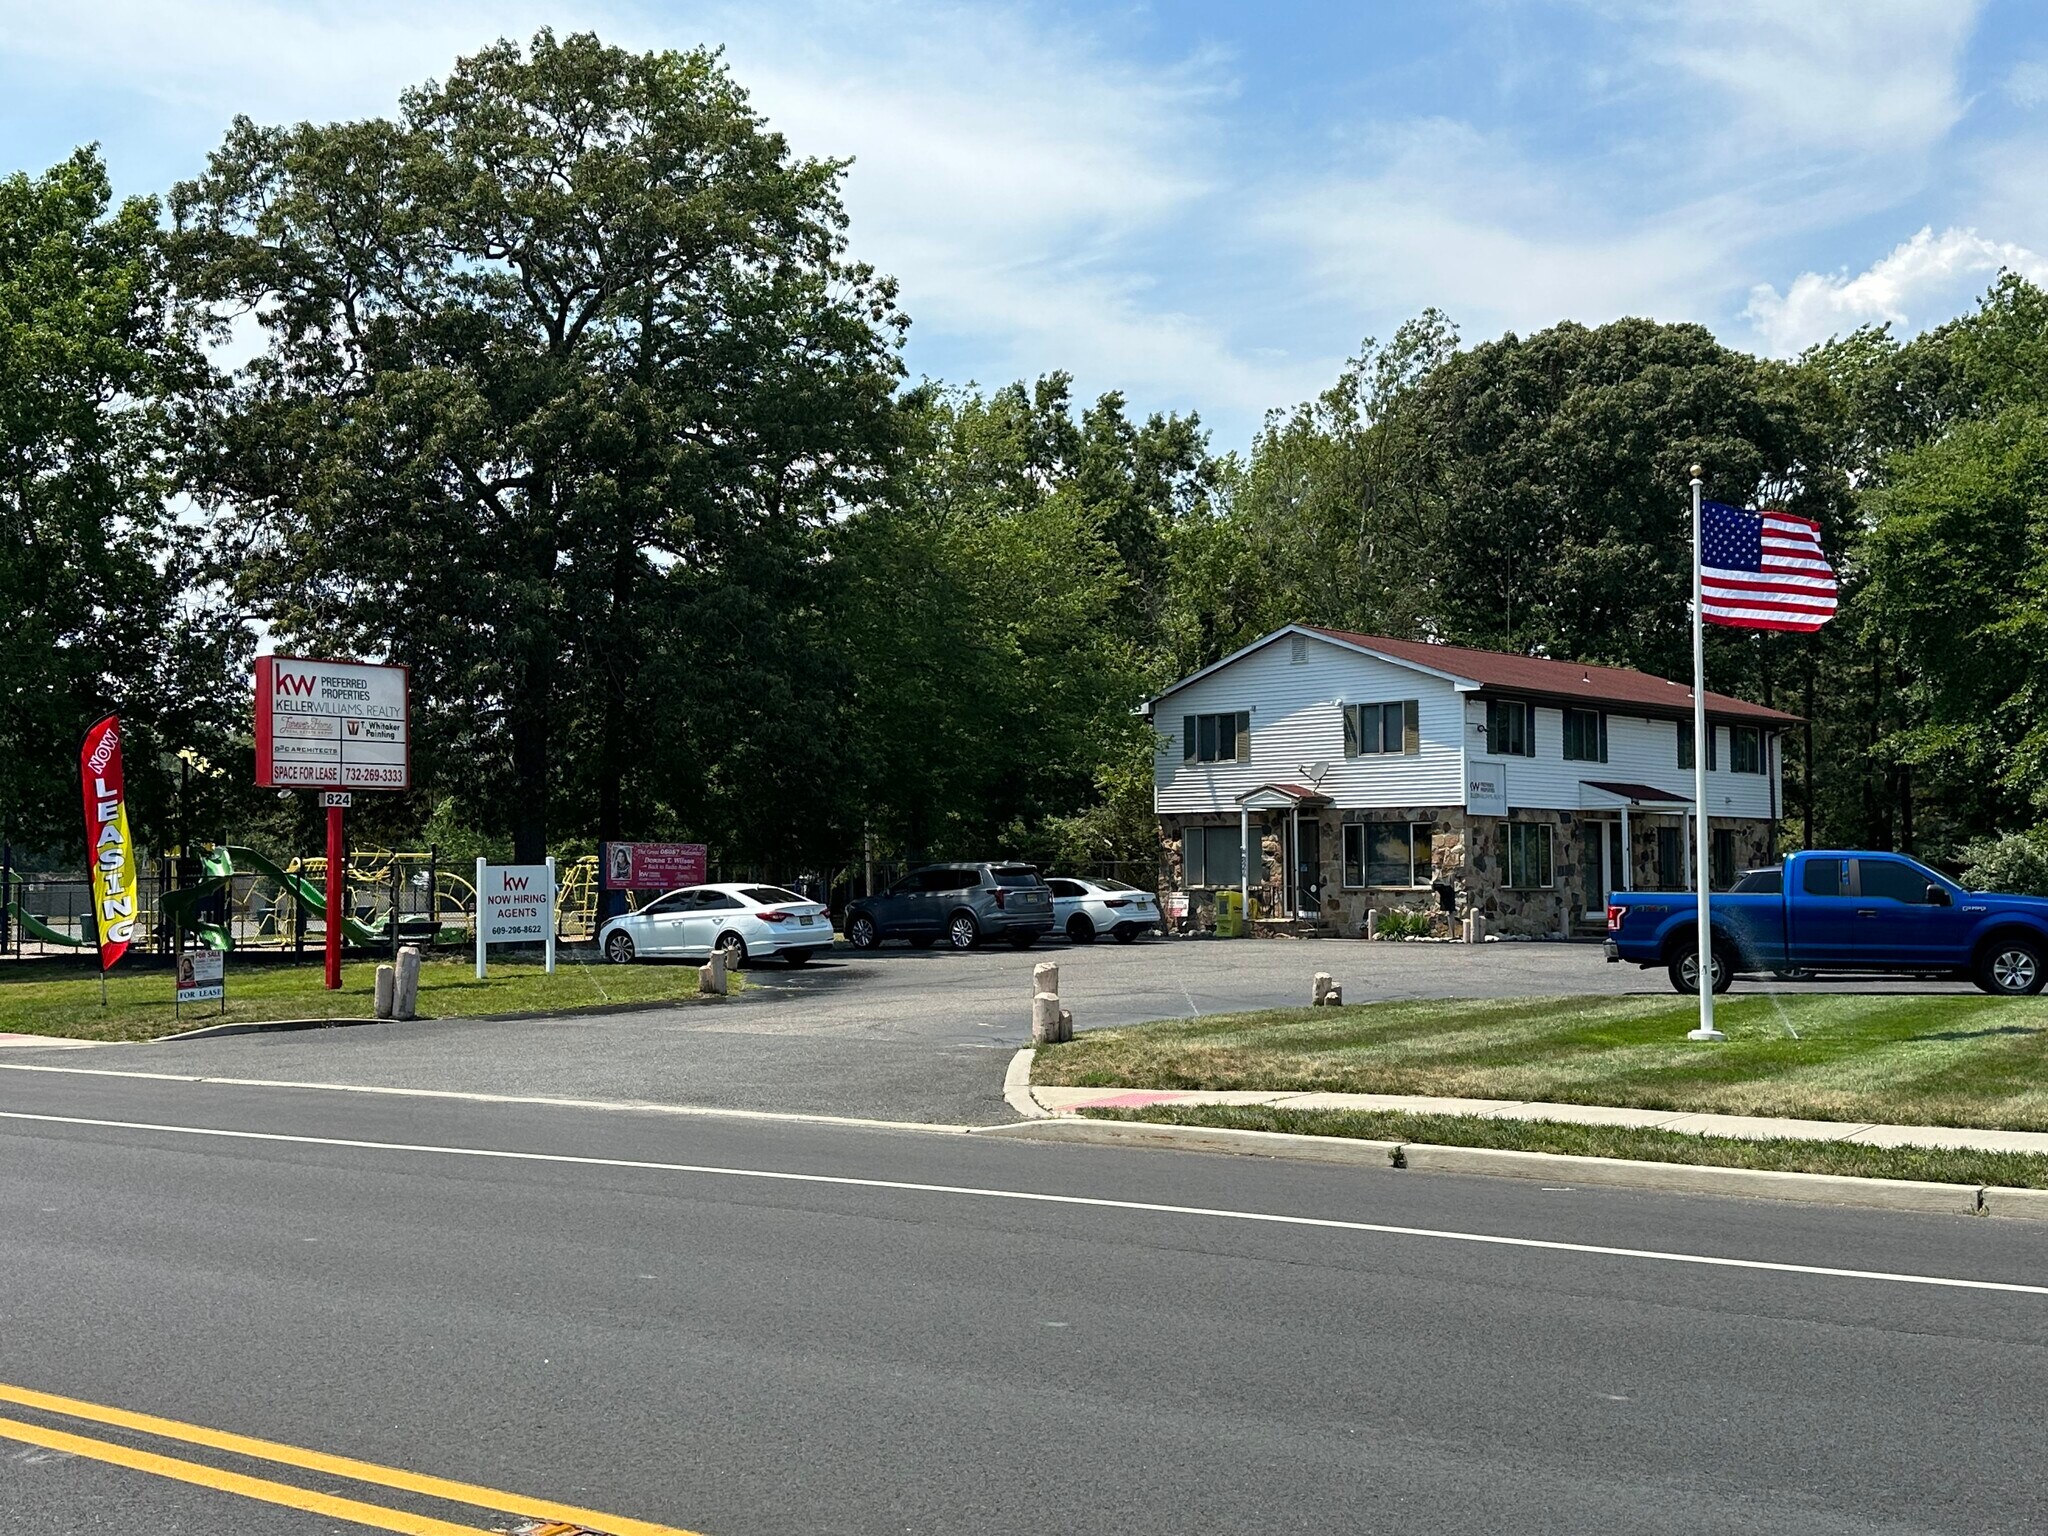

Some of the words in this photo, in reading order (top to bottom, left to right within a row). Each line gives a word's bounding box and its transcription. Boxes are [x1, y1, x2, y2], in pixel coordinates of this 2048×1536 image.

[321, 676, 367, 689] PREFERRED
[321, 688, 370, 701] PROPERTIES
[366, 705, 401, 718] REALTY
[368, 721, 400, 732] Whitaker
[366, 729, 395, 740] Painting
[88, 728, 119, 774] NOW
[291, 746, 338, 754] ARCHITECTS
[274, 766, 298, 780] SPACE
[299, 766, 314, 780] FOR
[315, 767, 337, 781] LEASE
[345, 768, 402, 782] 732-269-3333
[326, 793, 350, 805] 824
[95, 778, 134, 943] LEASING
[504, 871, 529, 891] kw
[488, 895, 511, 905] NOW
[514, 894, 547, 904] HIRING
[497, 908, 537, 918] AGENTS
[199, 989, 221, 997] LEASE
